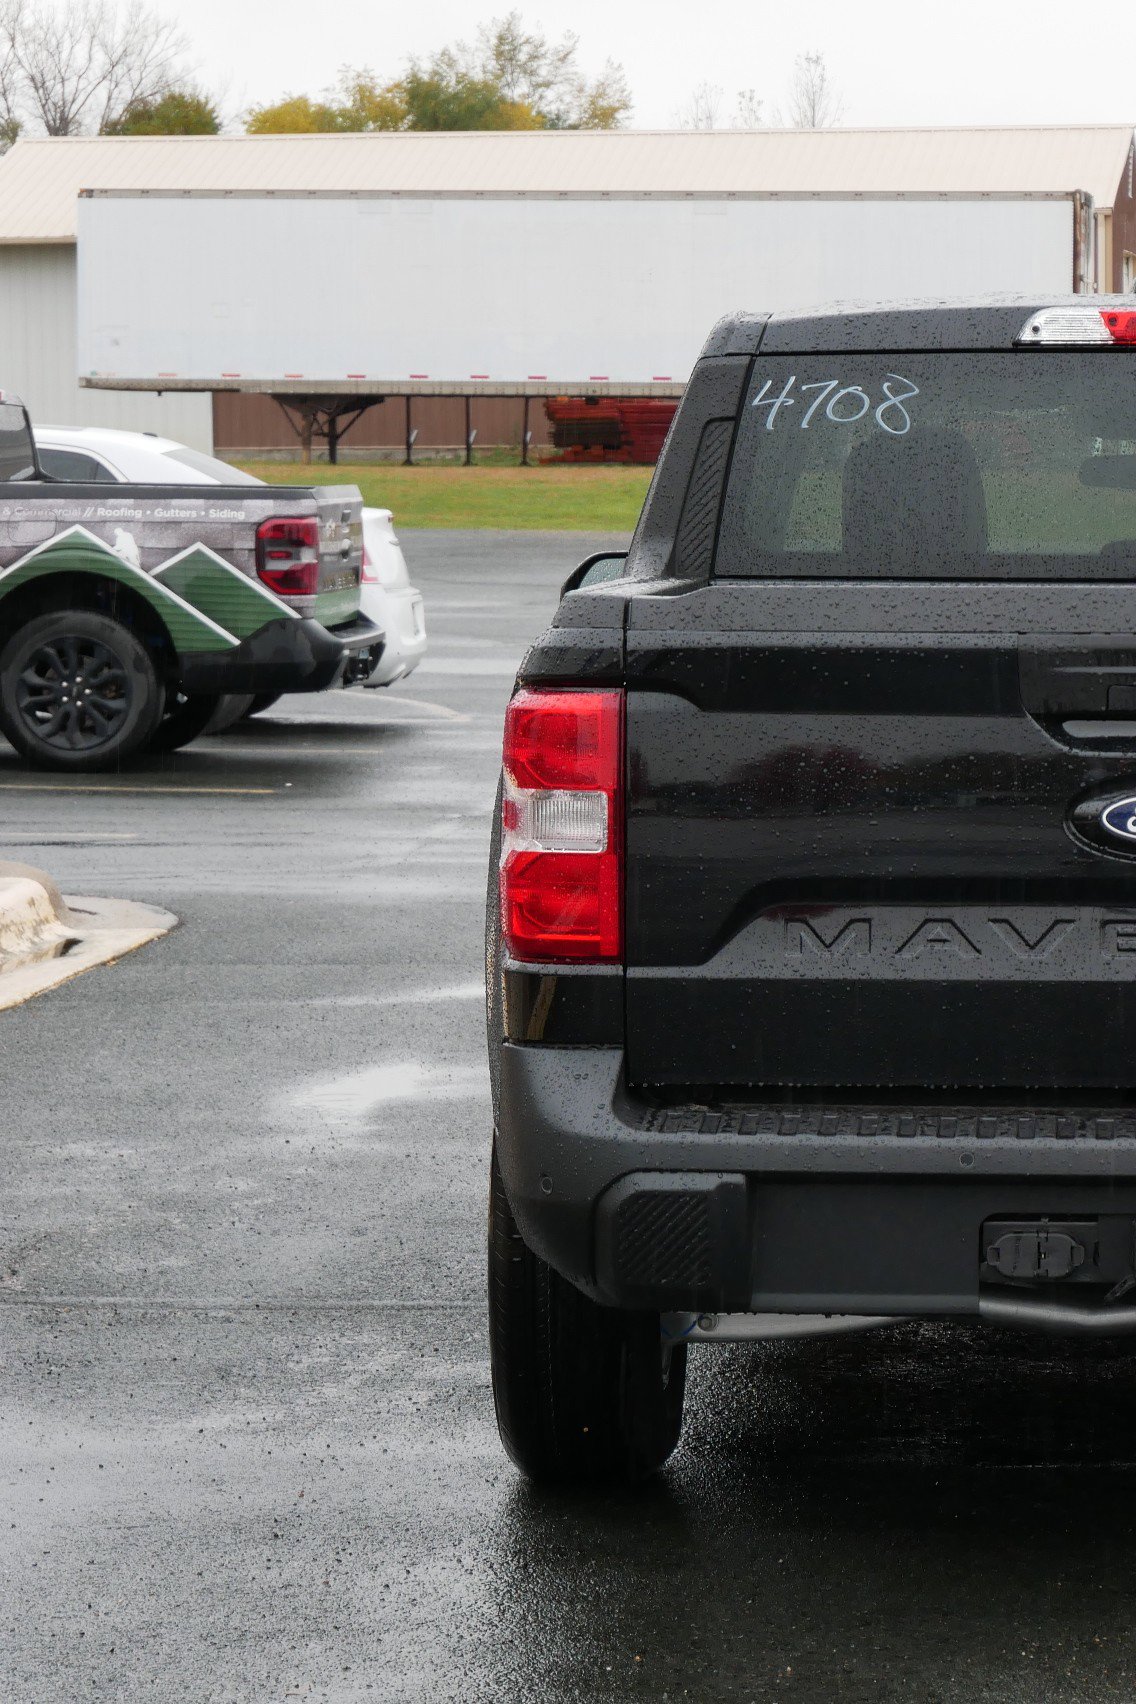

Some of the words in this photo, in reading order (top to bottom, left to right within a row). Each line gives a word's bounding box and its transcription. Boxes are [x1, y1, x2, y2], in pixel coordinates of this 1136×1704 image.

[752, 373, 920, 435] 4708
[97, 507, 142, 519] Roofing
[154, 508, 197, 518] Gutters
[209, 508, 245, 520] Siding
